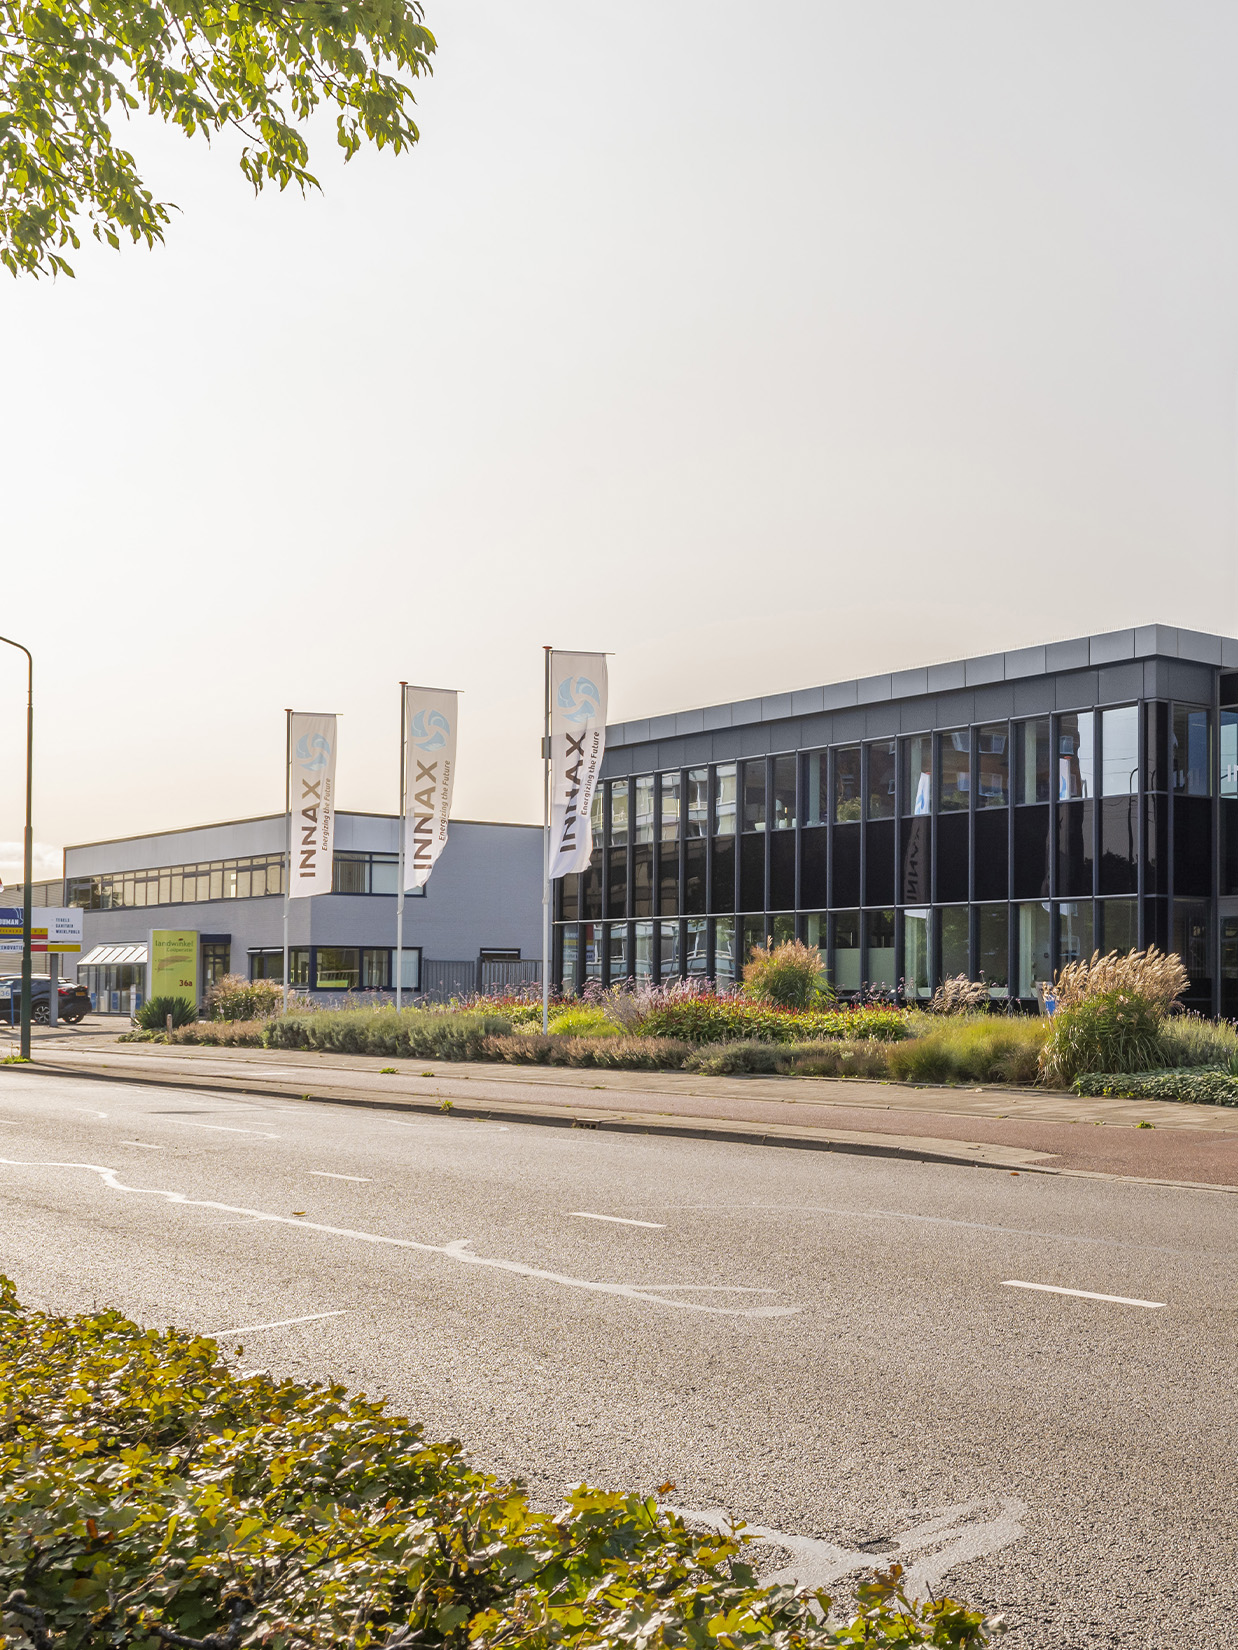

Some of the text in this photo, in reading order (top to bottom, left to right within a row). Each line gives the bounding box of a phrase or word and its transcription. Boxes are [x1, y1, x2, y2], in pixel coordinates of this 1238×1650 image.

[442, 759, 451, 788] Future
[559, 732, 586, 853] INNAX
[581, 773, 595, 816] Energizing
[591, 731, 600, 759] Future
[299, 778, 321, 878] INNAX
[321, 815, 331, 852] Energizing
[413, 759, 438, 870] INNAX
[438, 804, 449, 842] Energizing
[179, 979, 193, 987] 36a
